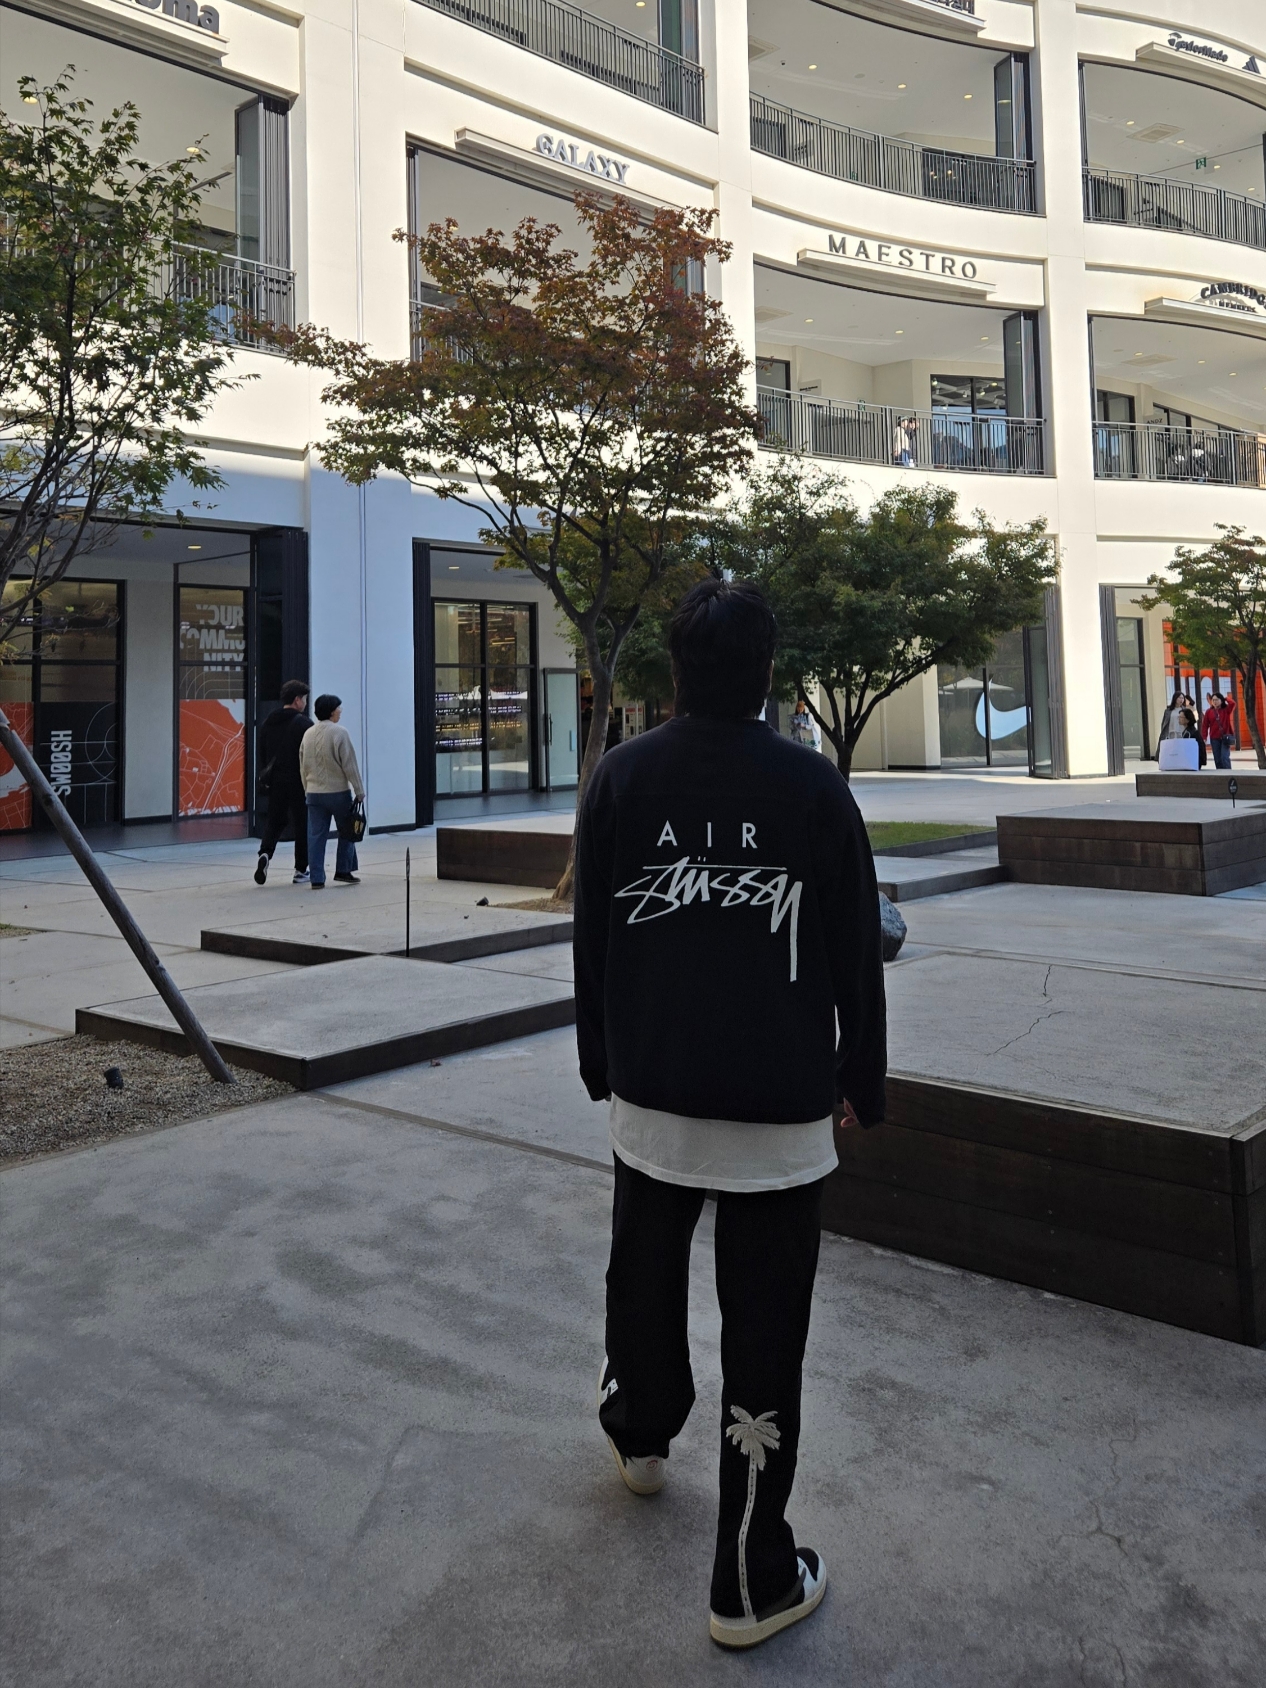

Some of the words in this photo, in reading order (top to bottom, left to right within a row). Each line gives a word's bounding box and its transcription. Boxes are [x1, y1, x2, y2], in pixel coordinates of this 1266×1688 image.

[535, 132, 630, 185] GALAXY
[828, 234, 977, 279] MAESTRO
[1200, 282, 1266, 310] CAMBRIDG
[195, 604, 244, 627] YOUR
[656, 820, 758, 849] AIR
